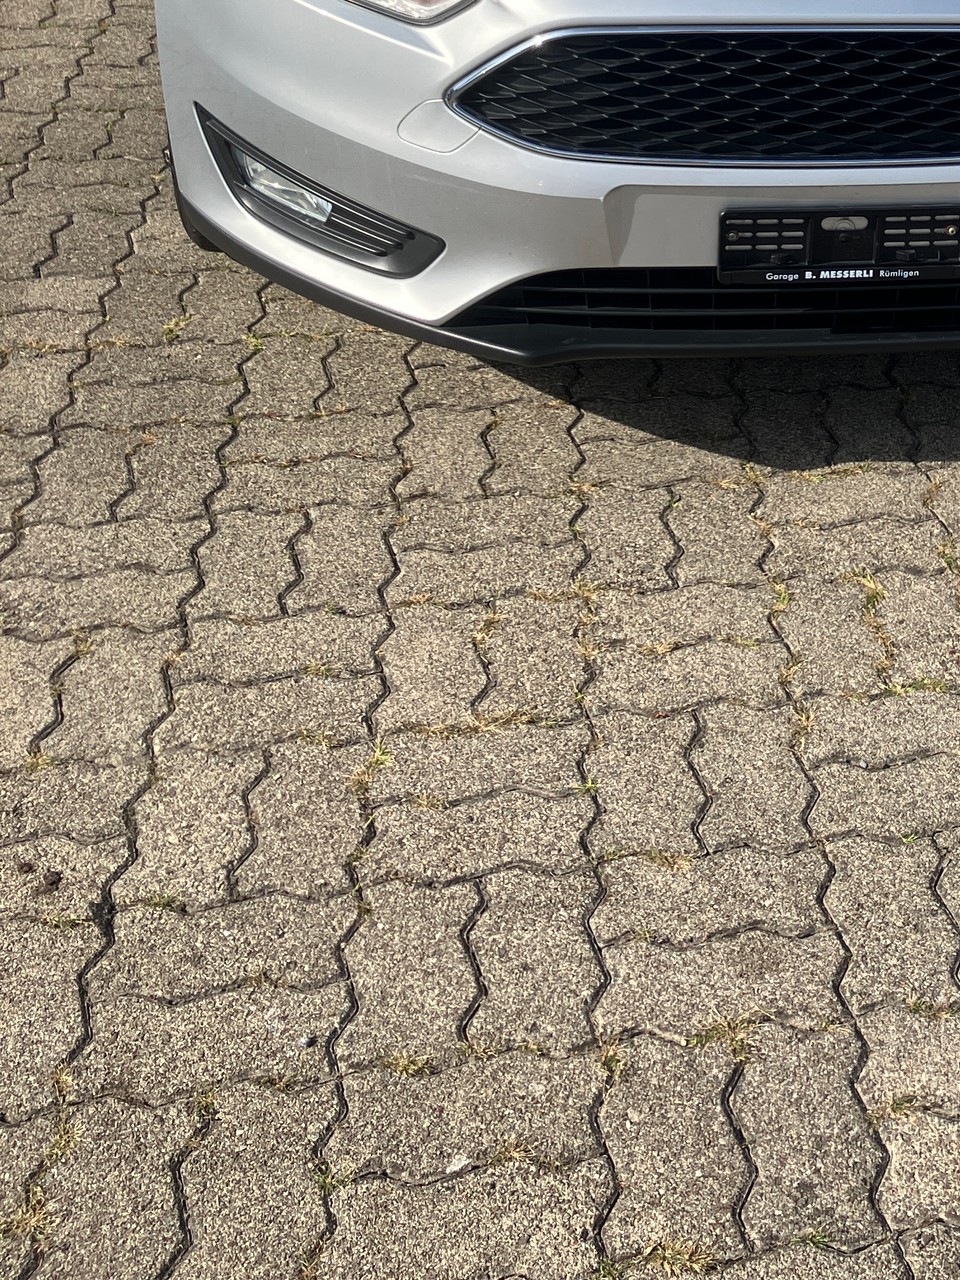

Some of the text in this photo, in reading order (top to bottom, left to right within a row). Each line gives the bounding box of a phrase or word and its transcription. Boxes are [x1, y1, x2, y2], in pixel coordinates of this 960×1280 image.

[765, 269, 920, 282] Garage B. MESSERLI Rümligen
